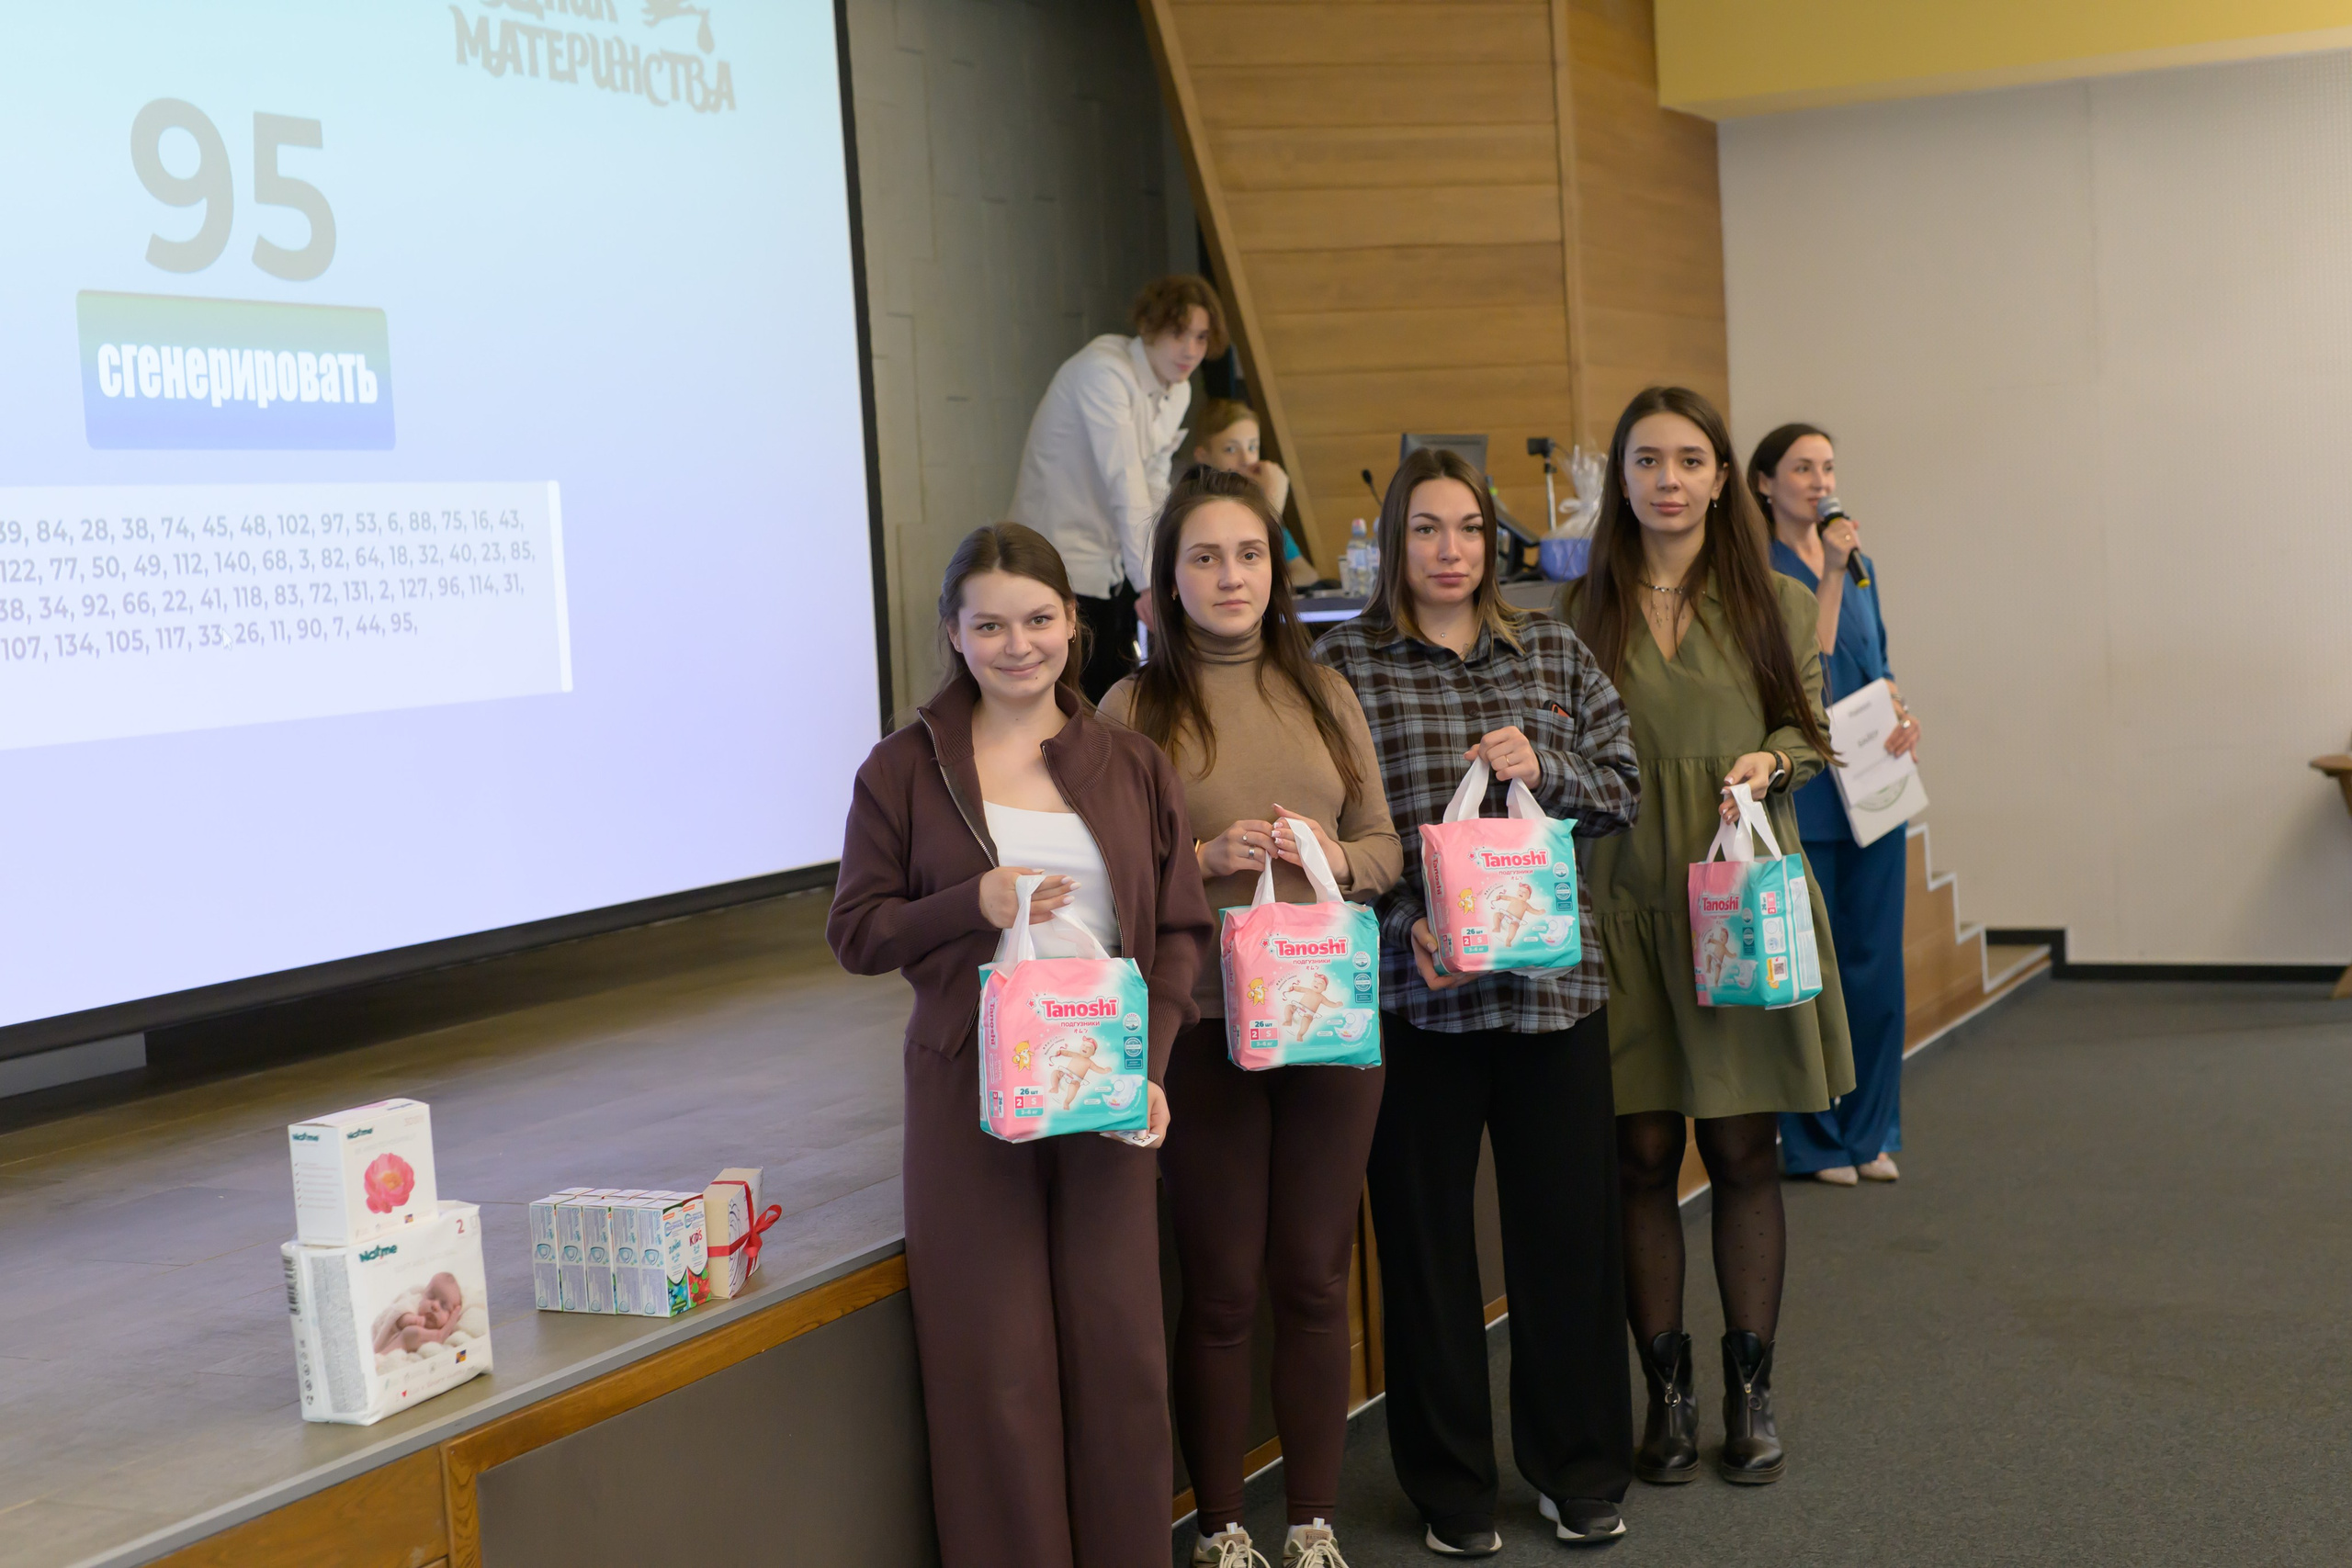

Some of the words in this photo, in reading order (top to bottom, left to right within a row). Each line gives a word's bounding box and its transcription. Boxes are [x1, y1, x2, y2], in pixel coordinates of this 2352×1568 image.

[448, 5, 737, 114] МАТЕРИНСТВА
[130, 97, 337, 282] 95
[97, 343, 379, 409] сгенерировать
[36, 519, 74, 547] 84,
[80, 517, 116, 546] 28,
[121, 516, 155, 544] 38,
[161, 516, 196, 543] 74,
[202, 514, 234, 542] 45,
[240, 514, 272, 540] 48,
[277, 513, 316, 539] 102,
[321, 512, 350, 537] 97,
[356, 512, 382, 536] 53,
[387, 512, 403, 536] 6,
[409, 511, 437, 535] 88,
[441, 510, 468, 534] 75,
[471, 510, 493, 533] 16,
[499, 509, 524, 532] 43,
[49, 556, 85, 584] 77,
[92, 555, 127, 583] 50,
[133, 553, 168, 581] 49,
[173, 551, 209, 579] 112,
[213, 549, 257, 577] 140,
[262, 548, 294, 574] 68,
[298, 547, 316, 573] 3,
[321, 547, 350, 571] 82,
[355, 546, 385, 570] 64,
[389, 544, 413, 569] 18,
[418, 543, 444, 568] 32,
[449, 542, 477, 566] 40,
[481, 541, 506, 564] 23,
[510, 540, 536, 562] 85,
[38, 594, 75, 623] 34,
[81, 592, 117, 621] 92,
[122, 590, 156, 618] 66,
[162, 588, 194, 616] 22,
[199, 586, 229, 615] 41,
[232, 584, 268, 612] 118,
[274, 582, 304, 609] 83,
[309, 581, 338, 606] 72,
[343, 580, 374, 604] 131,
[379, 579, 395, 604] 2,
[399, 576, 434, 601] 127,
[437, 575, 465, 599] 96,
[469, 574, 499, 596] 114,
[503, 572, 525, 595] 31,
[0, 635, 49, 663] 107,
[53, 632, 101, 660] 134,
[105, 627, 150, 656] 105,
[154, 625, 192, 652] 117,
[234, 620, 266, 647] 26,
[269, 618, 292, 645] 11,
[296, 616, 328, 642] 90,
[333, 615, 350, 640] 7,
[356, 614, 386, 637] 44,
[390, 611, 418, 636] 95,
[456, 1219, 465, 1234] 2
